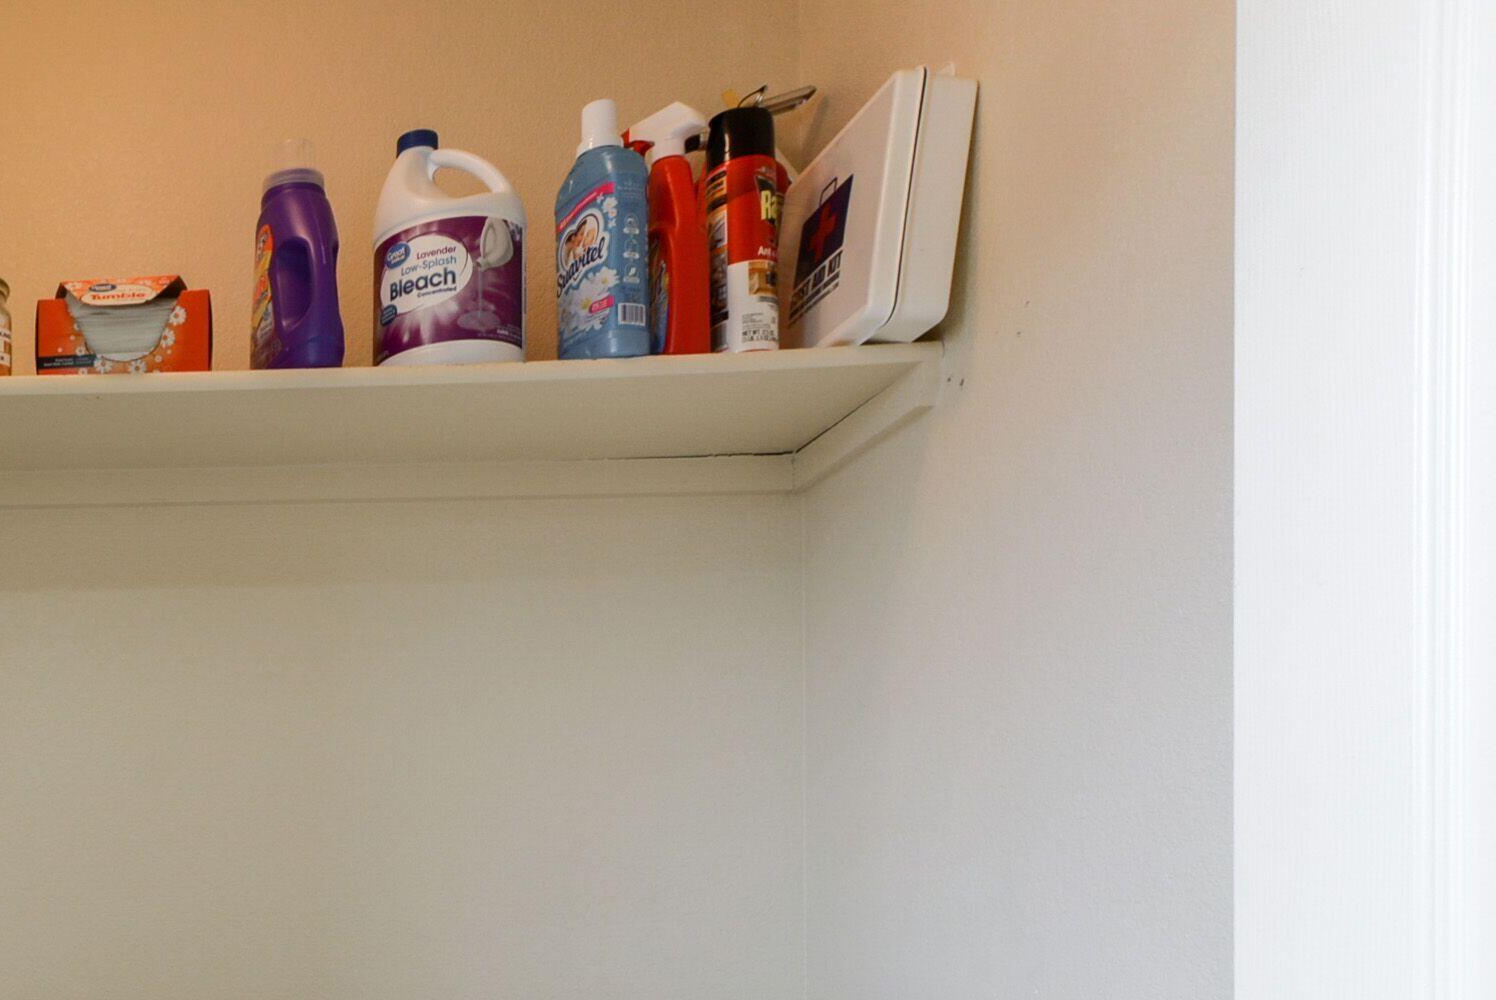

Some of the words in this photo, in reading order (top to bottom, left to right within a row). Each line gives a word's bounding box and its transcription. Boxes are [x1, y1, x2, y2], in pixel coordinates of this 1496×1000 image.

[401, 255, 457, 276] Low-Splash
[416, 246, 457, 260] Lavender
[557, 236, 605, 298] Suavitel
[390, 267, 456, 302] Bleach
